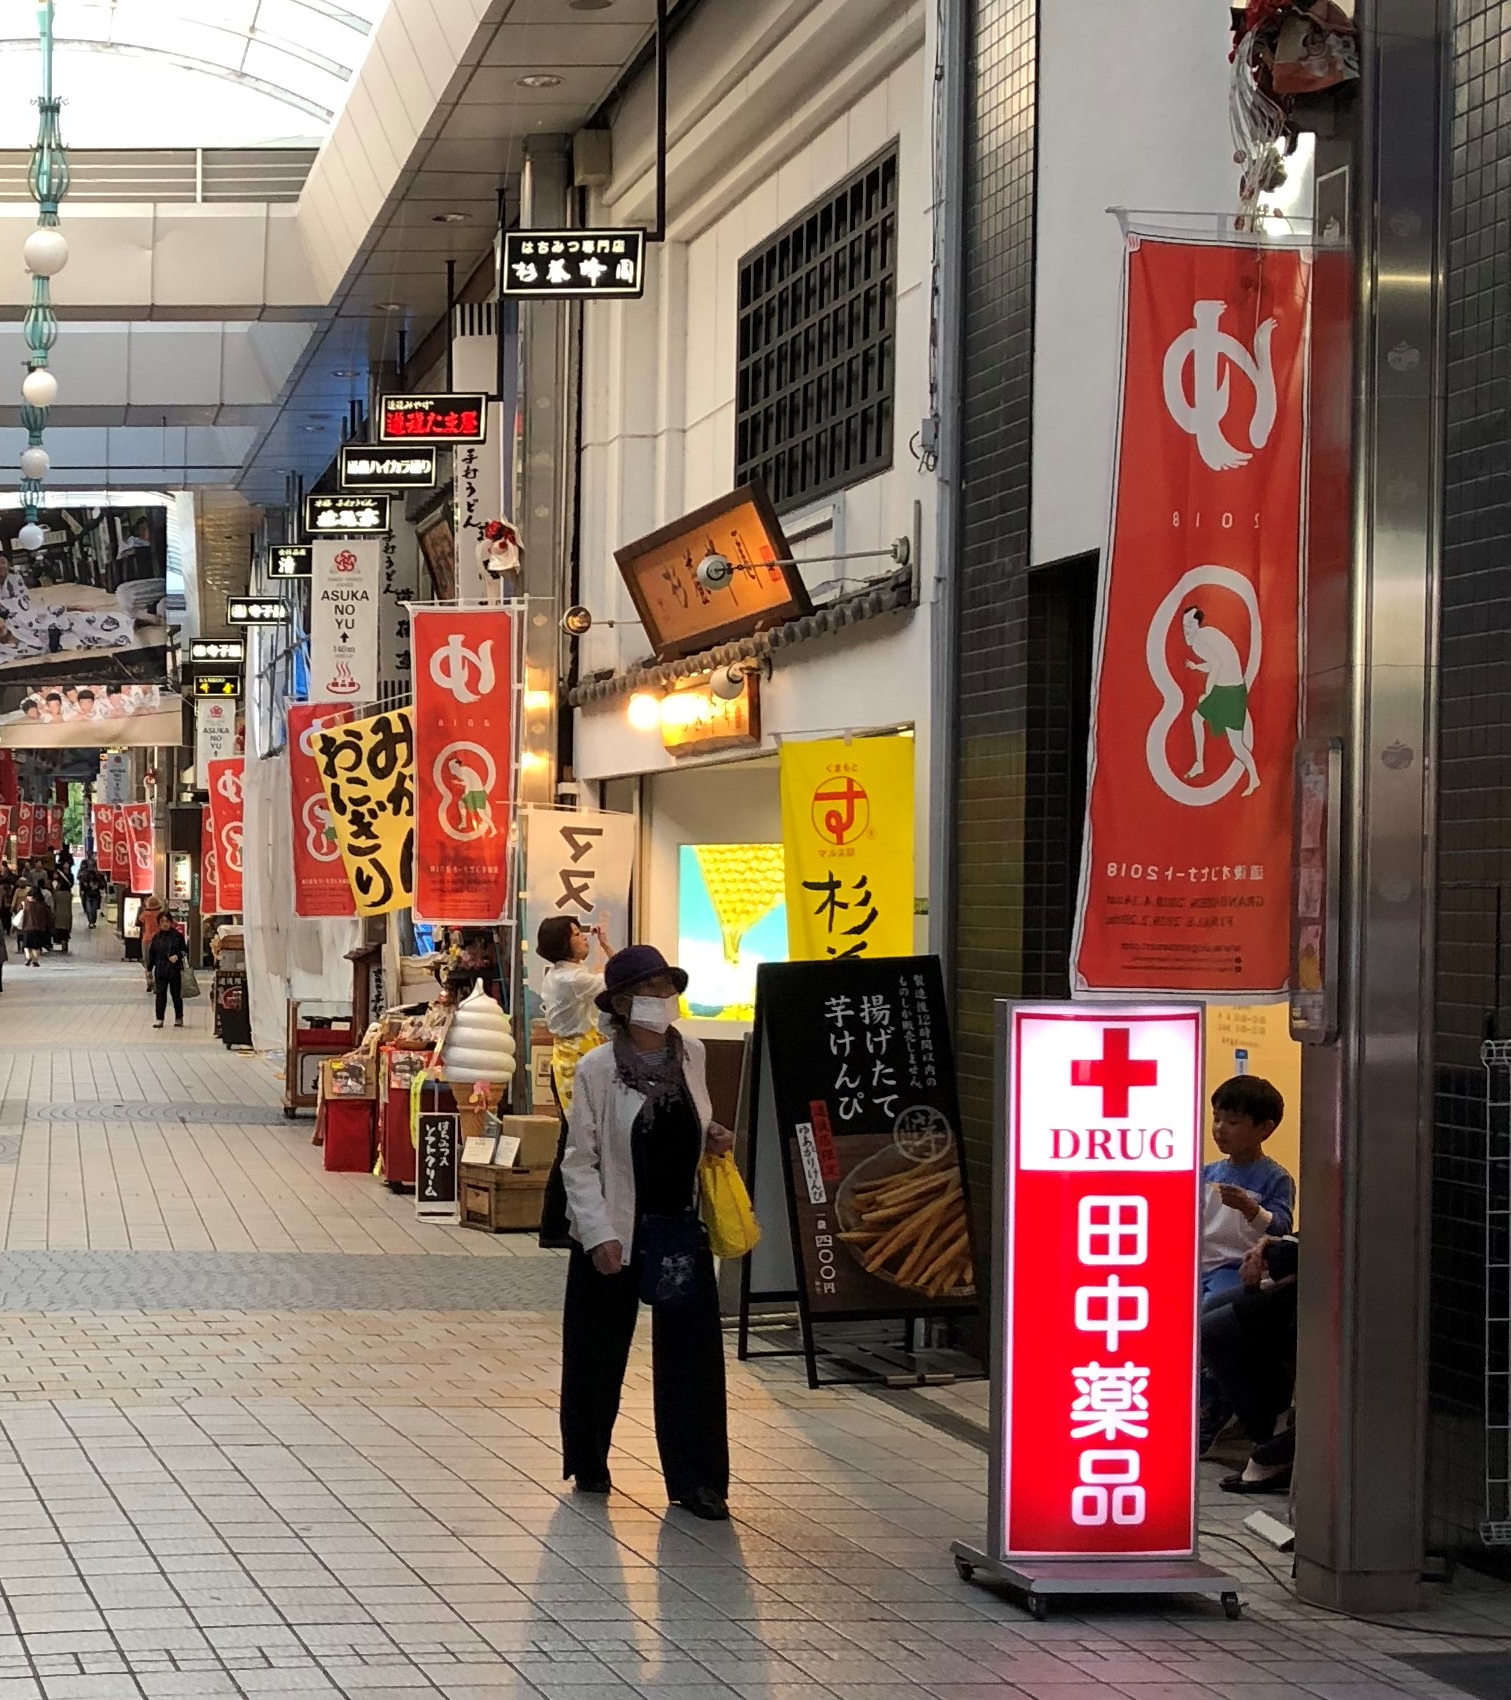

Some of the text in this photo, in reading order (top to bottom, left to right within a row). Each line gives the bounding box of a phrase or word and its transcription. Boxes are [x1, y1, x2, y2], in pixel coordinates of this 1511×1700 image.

[521, 239, 625, 255] はちみつ専門店
[460, 449, 482, 528] 手打うどん
[321, 590, 370, 601] ASUKA
[334, 604, 356, 615] NO
[335, 619, 355, 629] YU
[826, 763, 858, 773] くまもと
[319, 729, 393, 908] おにぎり
[818, 848, 856, 858] マルス印
[801, 870, 879, 959] 杉
[824, 995, 865, 1120] 芋けんぴ
[859, 994, 900, 1118] 揚げたて
[424, 1124, 438, 1197] ソフトクリーム
[1049, 1127, 1175, 1160] DRUG
[1069, 1194, 1151, 1526] 田中薬品
